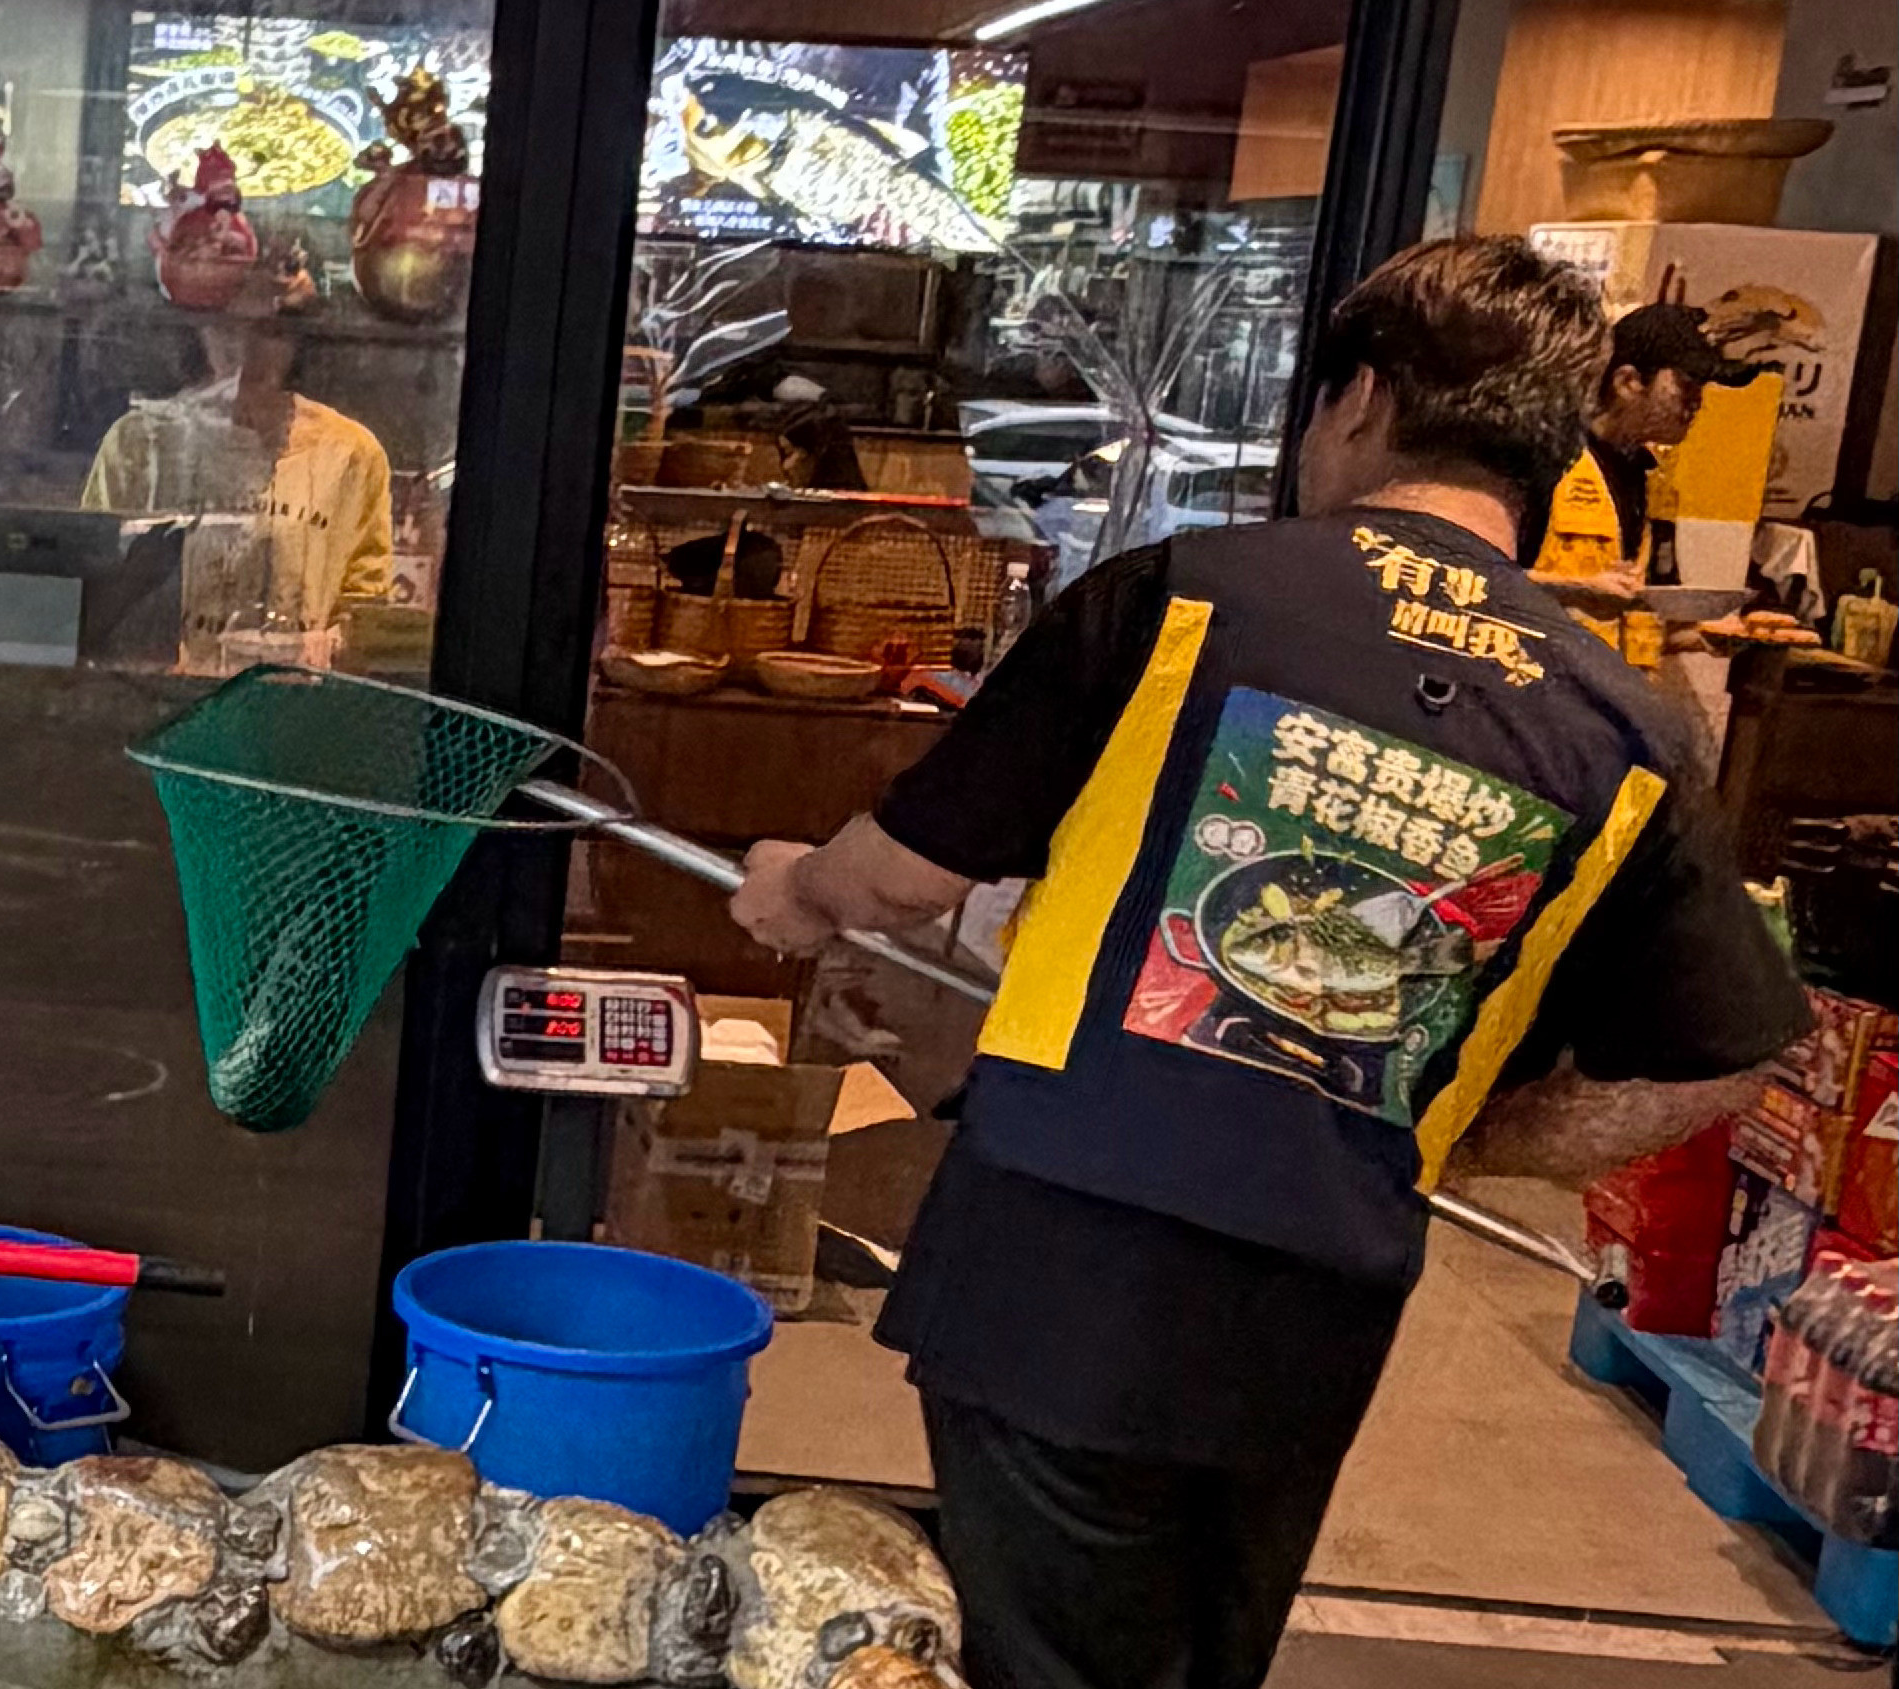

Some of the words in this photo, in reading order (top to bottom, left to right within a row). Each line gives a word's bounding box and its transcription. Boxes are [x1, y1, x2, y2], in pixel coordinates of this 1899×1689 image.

[1267, 764, 1481, 880] 青花椒香鱼
[1271, 712, 1516, 838] 安富贵爆炒
